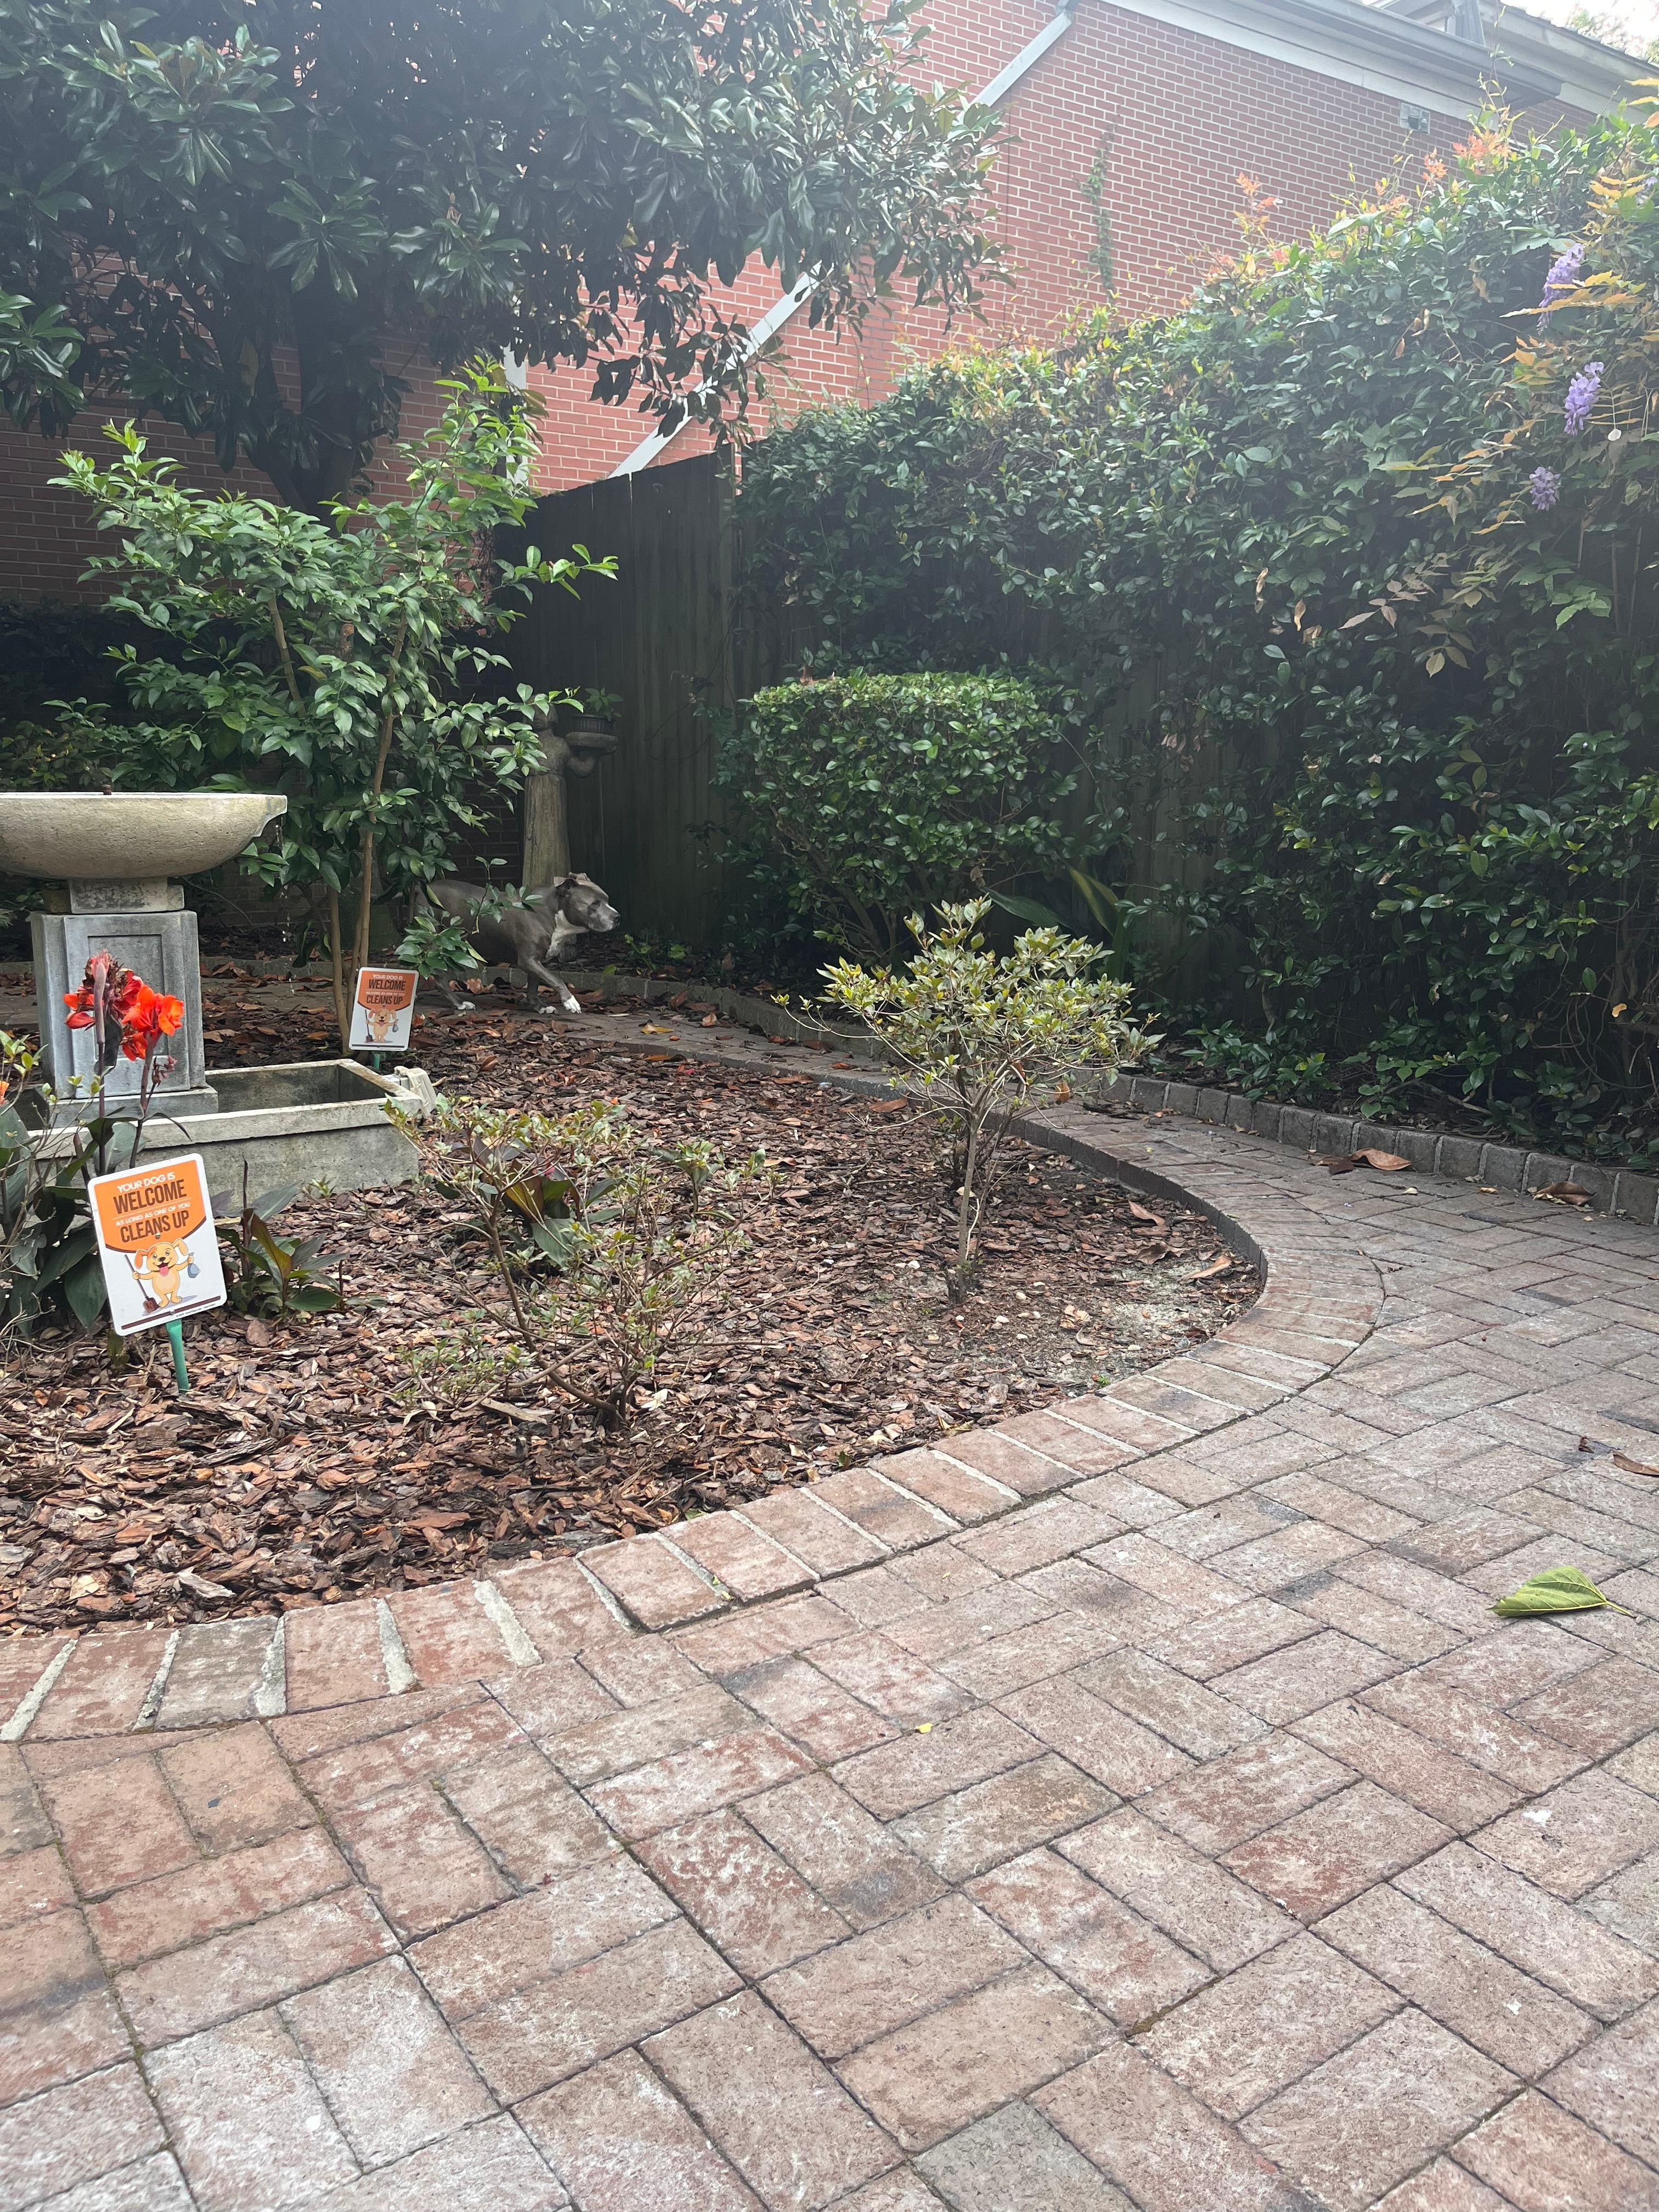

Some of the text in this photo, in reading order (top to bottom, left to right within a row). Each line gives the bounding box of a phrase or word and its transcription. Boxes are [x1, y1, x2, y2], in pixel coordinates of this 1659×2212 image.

[369, 979, 406, 990] WELCOME
[366, 995, 403, 1005] CLEANS UP
[117, 1172, 176, 1193] YOUR DOG IS
[113, 1179, 187, 1214] WELCOME
[120, 1210, 189, 1243] CLEANS UP
[125, 1215, 143, 1224] LONG
